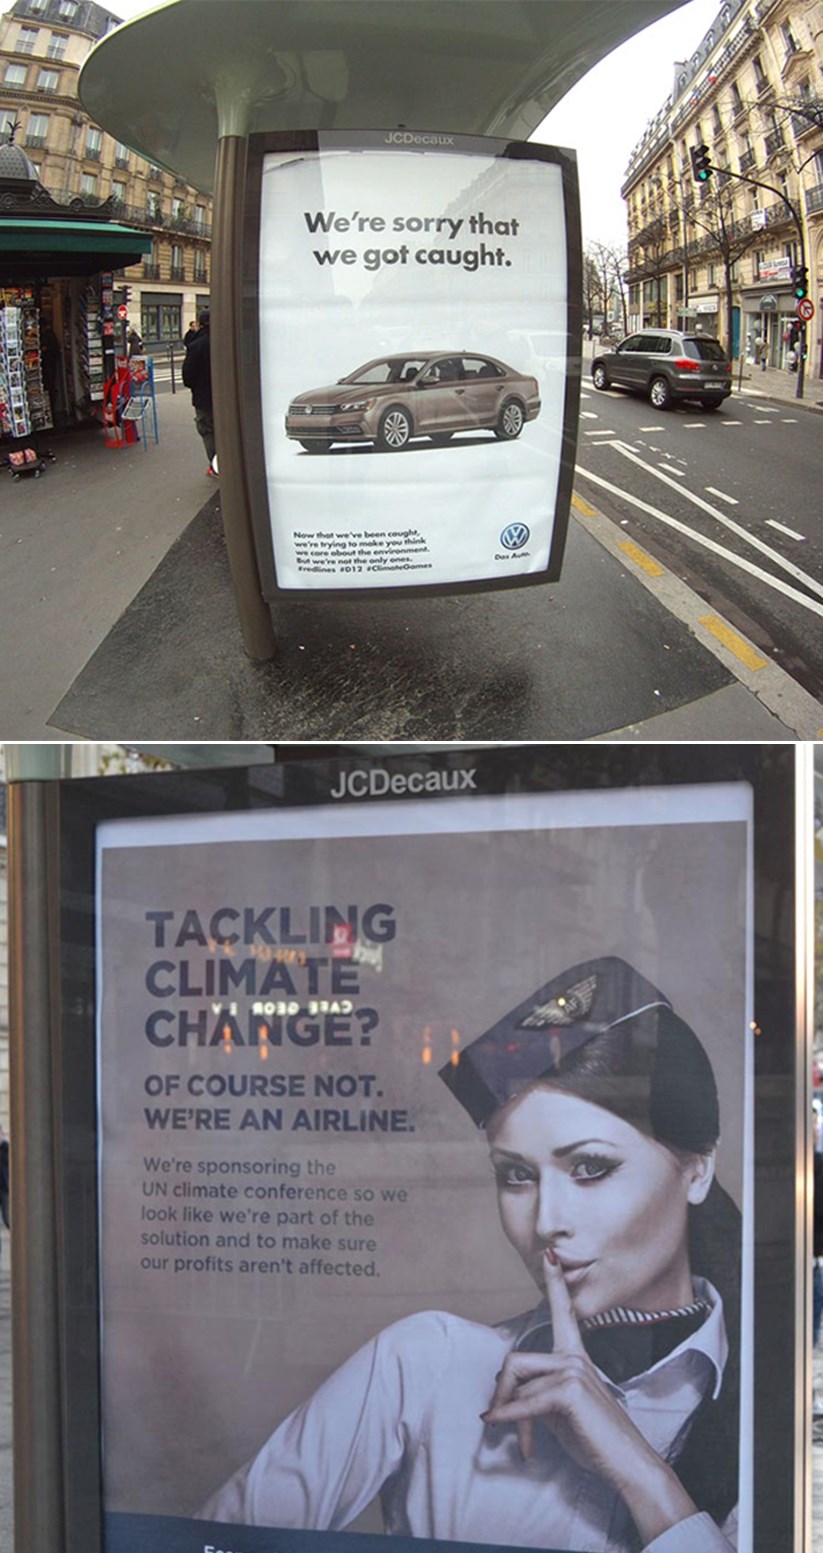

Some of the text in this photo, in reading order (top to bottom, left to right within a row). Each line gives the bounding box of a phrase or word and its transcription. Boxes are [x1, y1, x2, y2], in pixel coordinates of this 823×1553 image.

[384, 132, 455, 145] JCDecaux
[304, 211, 520, 239] We're sorry that
[313, 243, 512, 272] we got caught.
[320, 541, 346, 549] trying
[386, 540, 402, 548] you
[404, 537, 426, 545] think
[373, 546, 430, 556] environment.
[369, 557, 388, 565] only
[330, 768, 477, 799] JCDecaux
[145, 903, 397, 947] TACKLING
[145, 957, 360, 998] CLIMATE
[145, 1007, 380, 1047] CHANGE?
[144, 1074, 384, 1098] OF COURSE NOT.
[144, 1108, 415, 1132] WE'RE AN AIRLINE.
[143, 1156, 336, 1177] We're sponsoring the
[142, 1181, 408, 1202] UN climate conference so we
[141, 1205, 375, 1227] look like we're part of the
[140, 1230, 377, 1252] solution and to make sure
[140, 1256, 381, 1277] our profits aren't affected.
